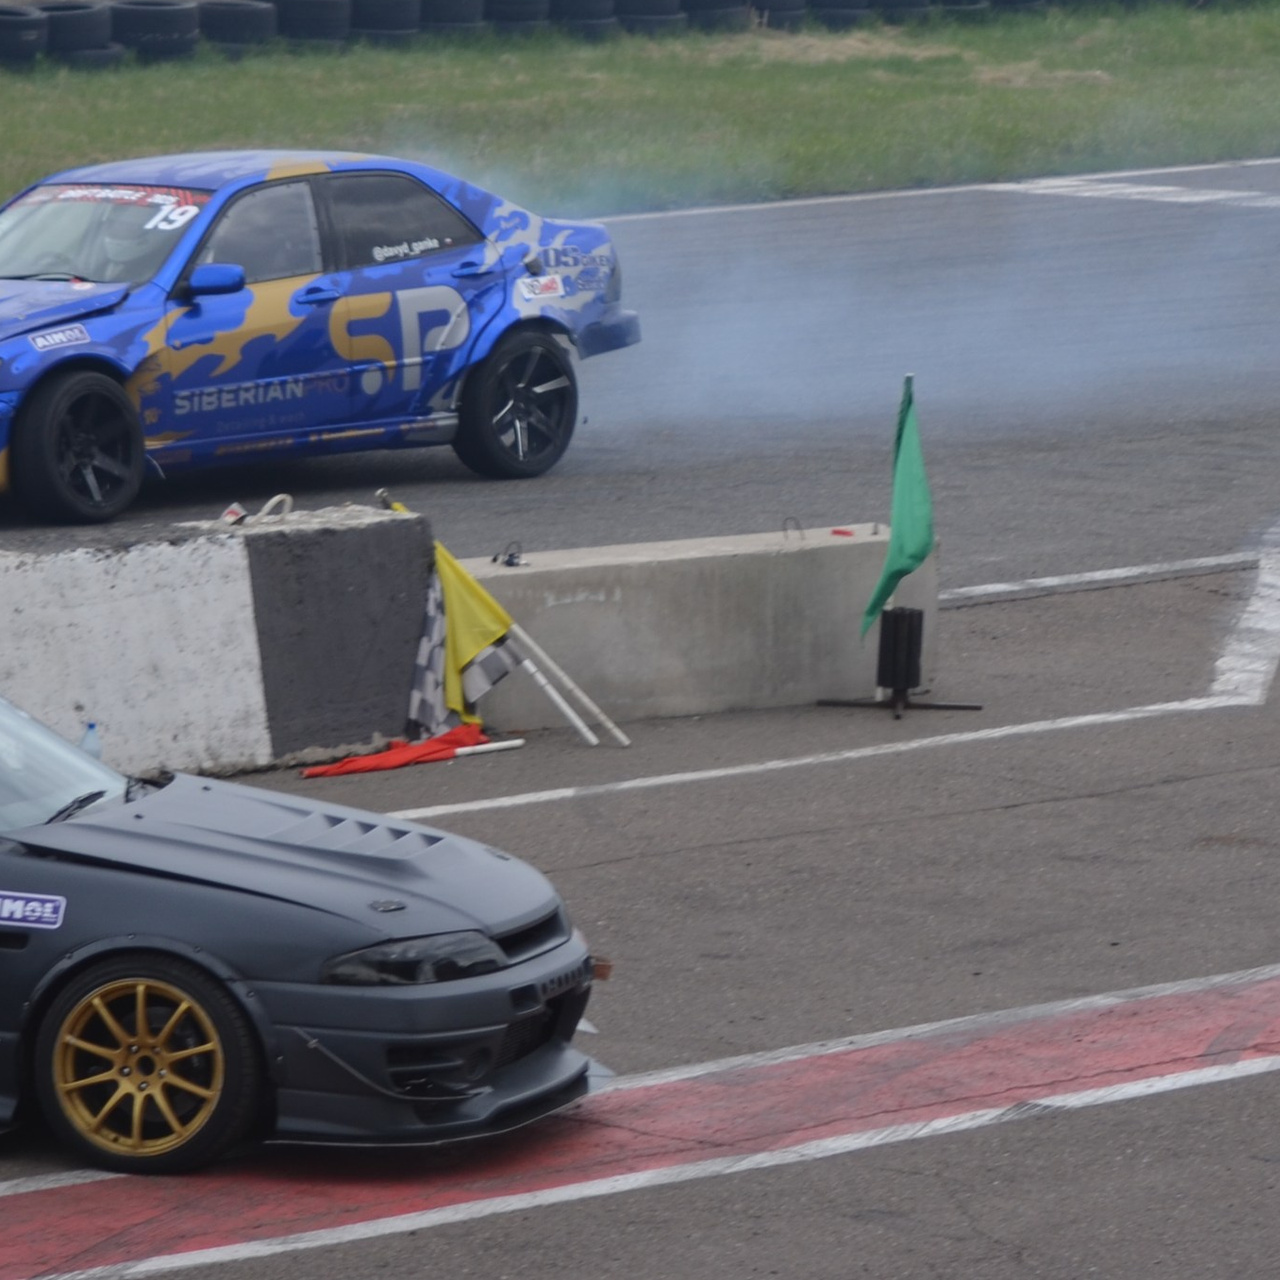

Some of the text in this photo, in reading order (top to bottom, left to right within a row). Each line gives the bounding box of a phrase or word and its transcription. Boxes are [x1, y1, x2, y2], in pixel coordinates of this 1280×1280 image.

[144, 204, 200, 230] 19
[35, 327, 83, 348] AIMOL
[0, 898, 58, 922] MOL
